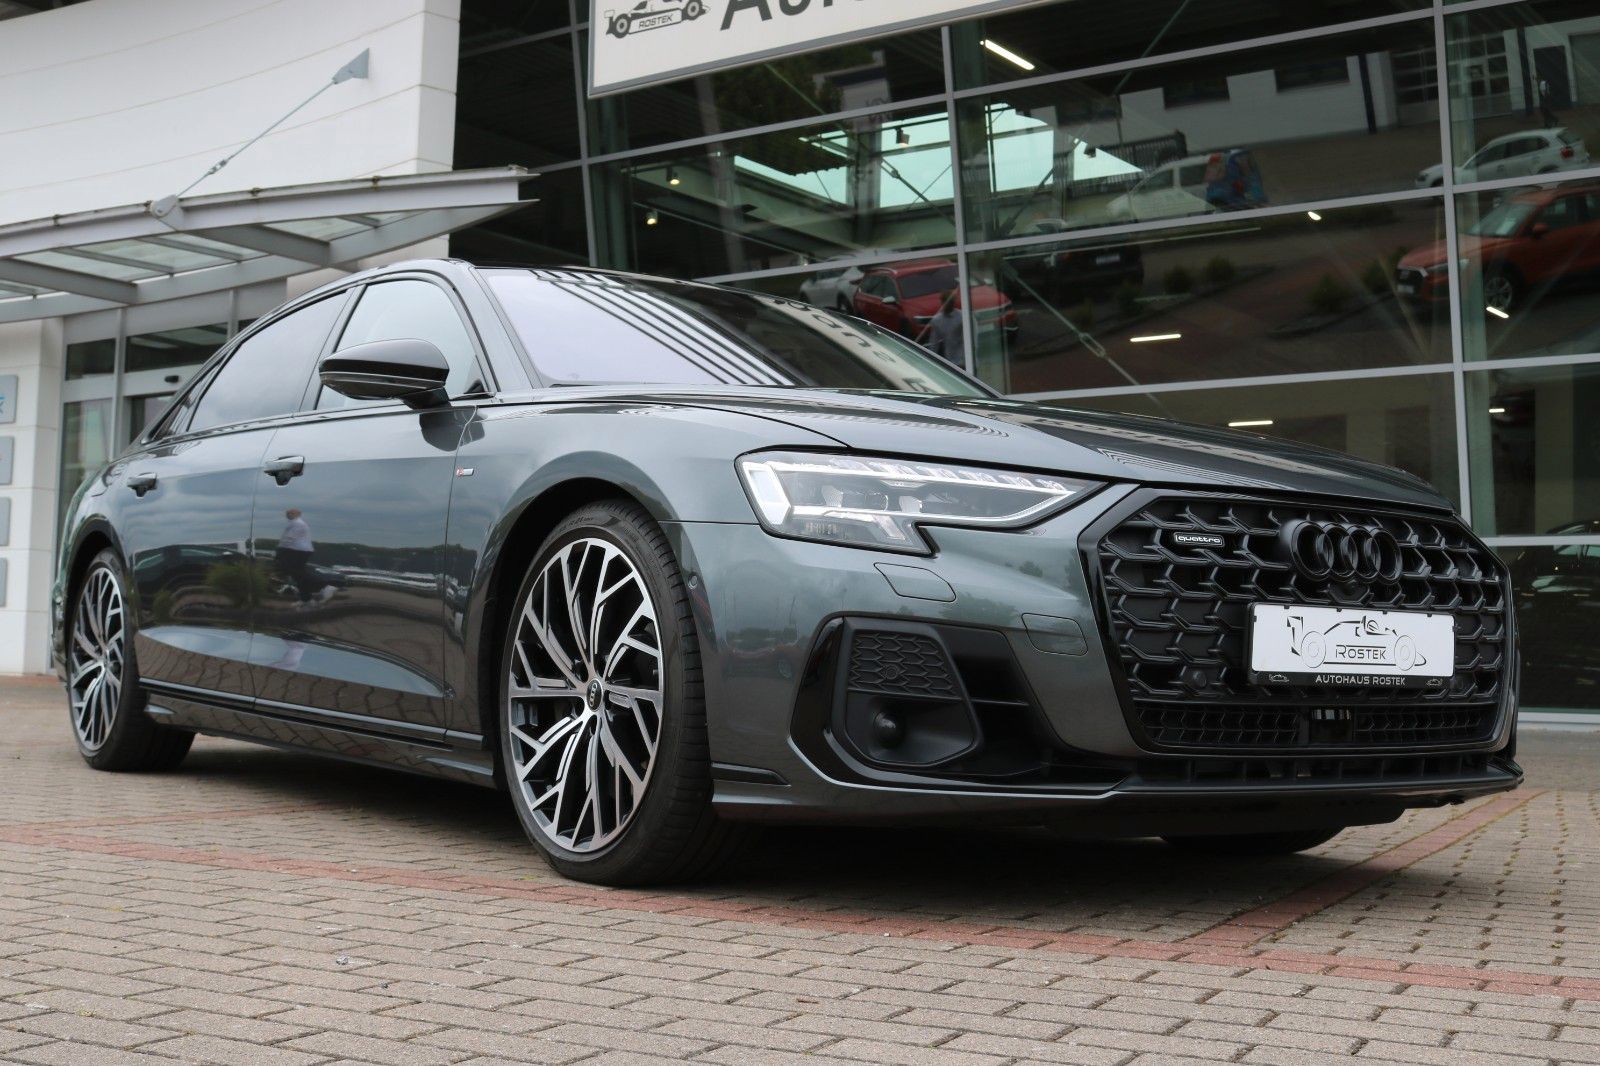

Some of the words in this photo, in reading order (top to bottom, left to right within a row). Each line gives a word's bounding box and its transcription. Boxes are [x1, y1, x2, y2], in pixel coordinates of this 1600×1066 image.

[639, 13, 673, 29] ROSTEK
[1178, 535, 1220, 543] quattro
[1315, 674, 1370, 685] AUTOHAUS
[1372, 676, 1406, 686] ROSTEK
